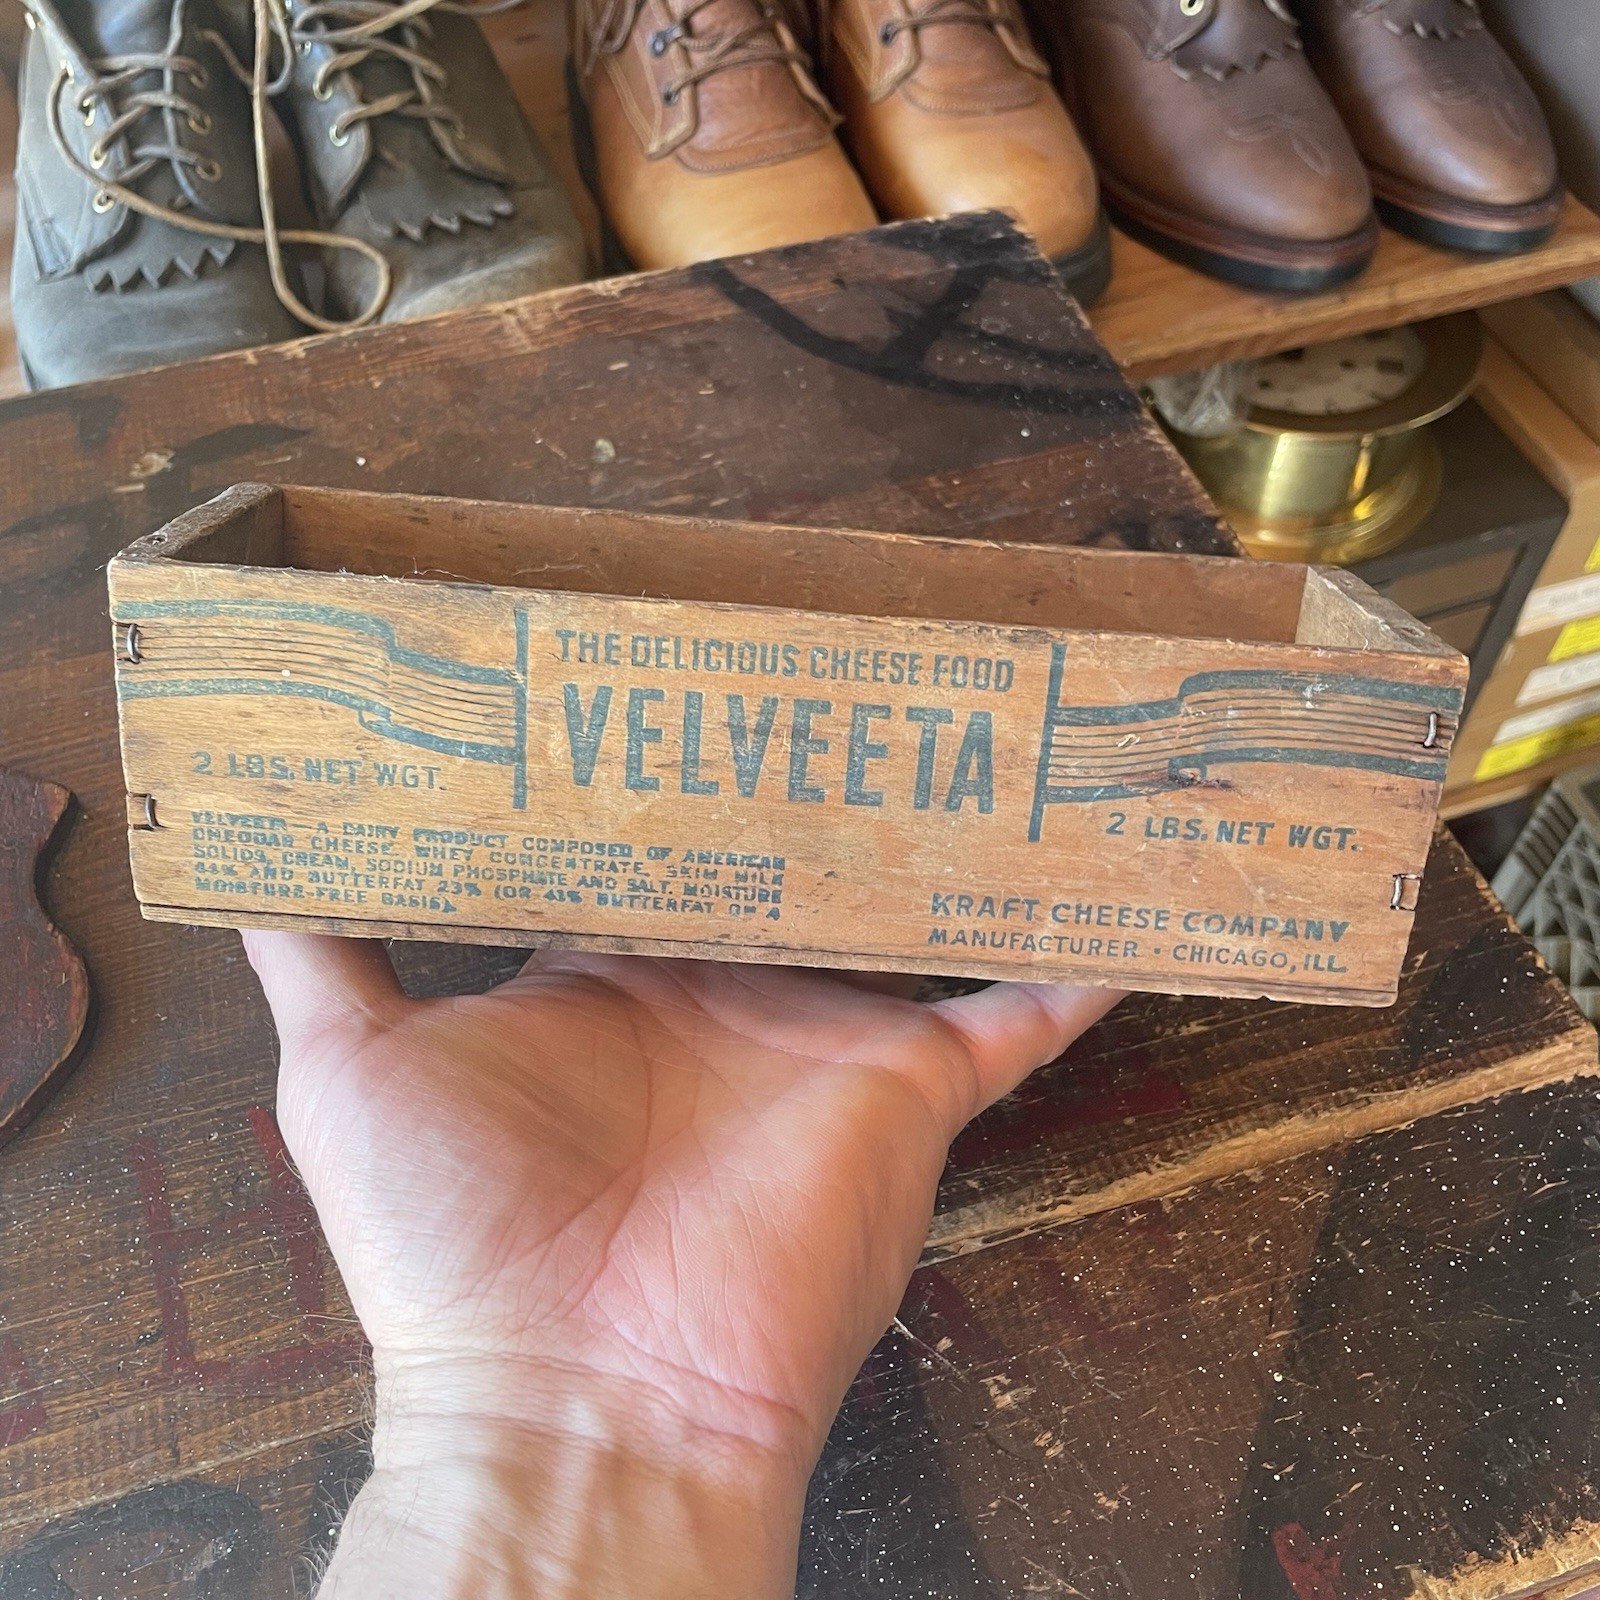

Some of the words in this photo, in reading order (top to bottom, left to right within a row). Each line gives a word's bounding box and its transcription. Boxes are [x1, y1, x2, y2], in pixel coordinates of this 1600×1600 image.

[555, 628, 622, 666] THE
[631, 634, 799, 677] DELICIOUS
[810, 646, 924, 685] CHEESE
[932, 654, 1014, 693] FOOD
[191, 751, 213, 776] 2
[225, 752, 295, 780] LBS.
[304, 757, 362, 785] NET
[373, 761, 447, 791] WGT.
[563, 682, 994, 814] VELVEETA
[317, 821, 329, 834] A
[413, 827, 509, 848] PRODUCT
[522, 837, 632, 857] COMPOSED
[647, 846, 672, 861] OF
[681, 849, 785, 870] AMERICAN
[1106, 811, 1126, 836] 2
[1144, 817, 1208, 842] LBS.
[1216, 820, 1275, 846] NET
[1288, 825, 1360, 852] WGT.
[367, 858, 443, 877] SODIUM
[453, 864, 567, 886] PHOSPHATE
[577, 875, 618, 890] AND
[627, 878, 673, 895] SALT.
[683, 882, 782, 904] MOISTURE
[415, 844, 472, 861] WHEY
[665, 864, 718, 880] SKIM
[734, 870, 784, 886] MILK
[250, 866, 294, 880] AND
[307, 870, 425, 891] BUTTERFAT
[437, 880, 481, 896] 23%
[494, 884, 532, 899] (OR
[596, 892, 714, 914] BUTTERFAT
[931, 893, 1040, 922] KRAFT
[1051, 903, 1170, 931] CHEESE
[1182, 911, 1350, 943] COMPANY
[928, 929, 1139, 958] MANUFACTURER
[1172, 945, 1297, 974] CHICAGO,
